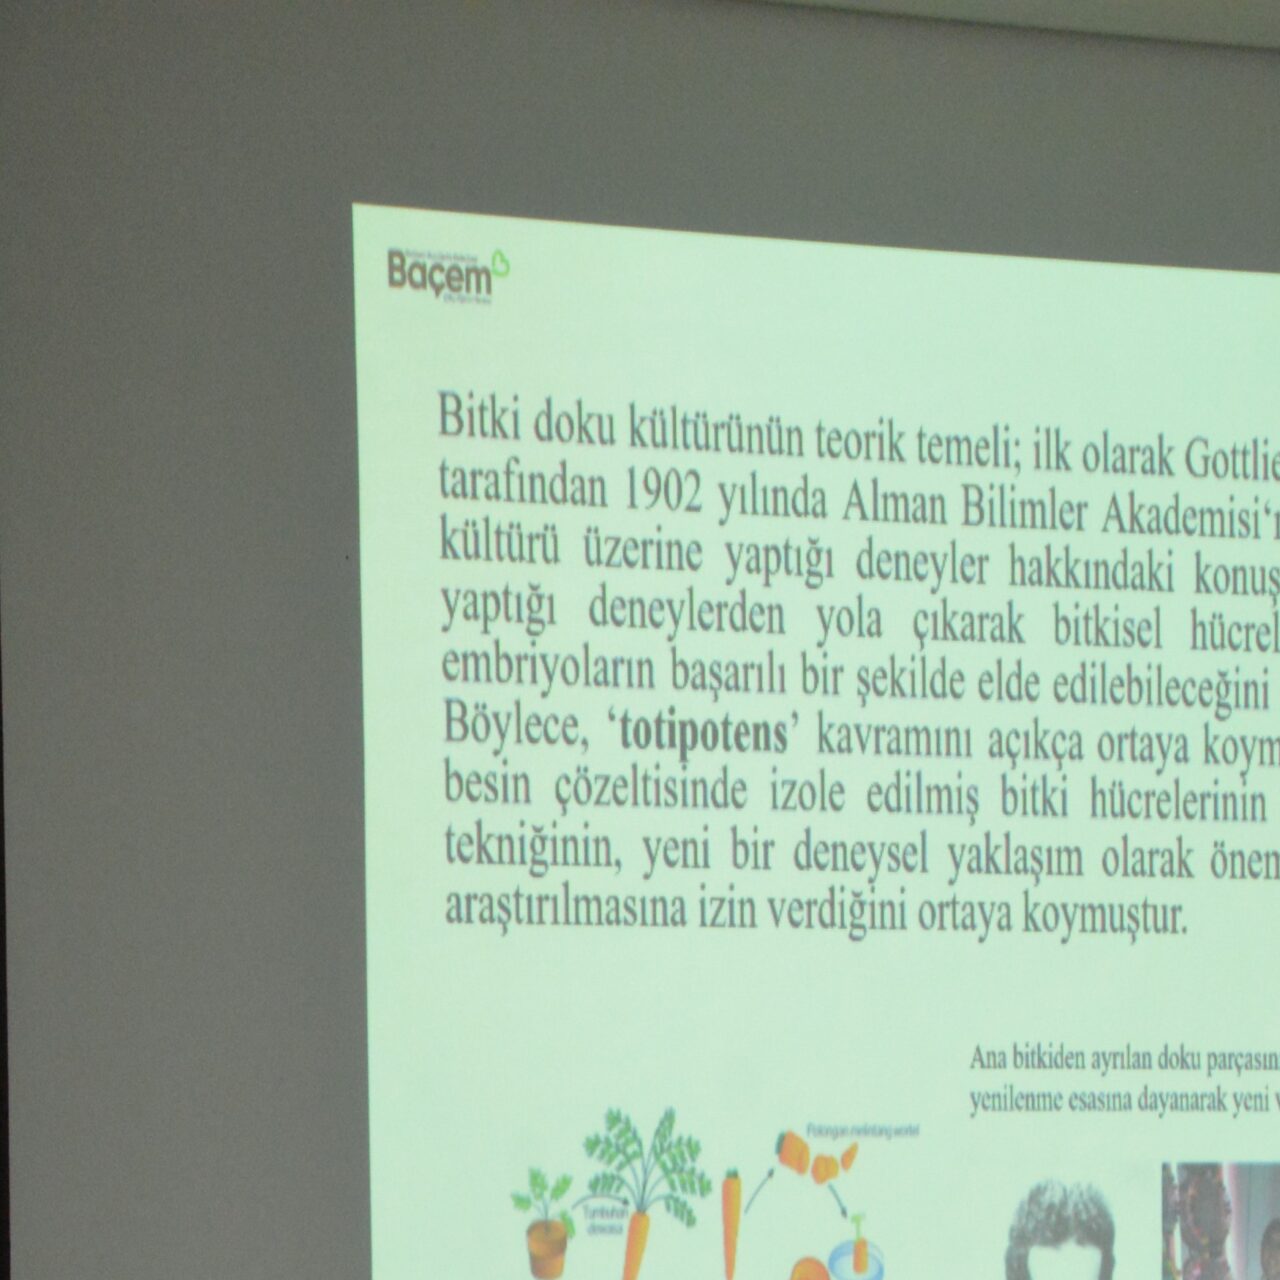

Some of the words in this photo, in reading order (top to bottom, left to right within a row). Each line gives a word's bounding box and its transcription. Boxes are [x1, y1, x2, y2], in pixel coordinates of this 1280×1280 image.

[388, 246, 492, 299] Baçem
[437, 389, 521, 441] Bitki
[533, 395, 616, 447] doku
[628, 400, 805, 458] kültürünün
[815, 416, 907, 464] teorik
[916, 422, 1021, 477] temeli;
[1033, 425, 1072, 473] ilk
[1082, 428, 1176, 478] olarak
[438, 455, 608, 508] tarafından
[627, 465, 703, 514] 1902
[717, 469, 828, 527] yılında
[842, 476, 948, 526] Alman
[960, 482, 1089, 532] Bilimler
[439, 512, 561, 566] kültürü
[583, 524, 703, 572] üzerine
[724, 536, 834, 591] yaptığı
[856, 534, 990, 595] deneyler
[1008, 541, 1175, 593] hakkındaki
[440, 581, 557, 638] yaptığı
[588, 580, 786, 643] deneylerden
[816, 592, 883, 645] yola
[912, 598, 1026, 654] çıkarak
[1052, 600, 1163, 650] bitkisel
[441, 637, 656, 699] embriyoların
[670, 644, 787, 703] başarılı
[800, 649, 844, 697] bir
[857, 652, 965, 708] şekilde
[977, 660, 1040, 704] elde
[1053, 660, 1270, 722] edilebileceğini
[443, 696, 589, 758] Böylece,
[817, 708, 973, 759] kavramını
[988, 724, 1085, 771] açıkça
[1097, 729, 1190, 777] ortaya
[443, 755, 532, 805] besin
[555, 761, 748, 817] çözeltisinde
[770, 765, 845, 813] izole
[866, 768, 980, 827] edilmiş
[1000, 771, 1068, 819] bitki
[1090, 774, 1268, 824] hücrelerinin
[444, 818, 622, 879] tekniğinin,
[642, 824, 711, 881] yeni
[730, 824, 775, 871] bir
[793, 826, 929, 885] deneysel
[947, 830, 1084, 887] yaklaşım
[1101, 833, 1195, 879] olarak
[445, 879, 688, 937] araştırılmasına
[699, 882, 758, 929] izin
[767, 884, 908, 943] verdiğini
[918, 896, 1013, 944] ortaya
[1022, 888, 1187, 946] koymuştur.
[969, 1043, 1008, 1070] Ana
[1012, 1041, 1086, 1071] bitkiden
[1091, 1042, 1153, 1078] ayrılan
[1157, 1042, 1202, 1071] doku
[969, 1083, 1064, 1119] yenilenme
[1068, 1091, 1133, 1112] esasına
[1137, 1083, 1228, 1119] dayanarak
[1232, 1084, 1270, 1119] yeni
